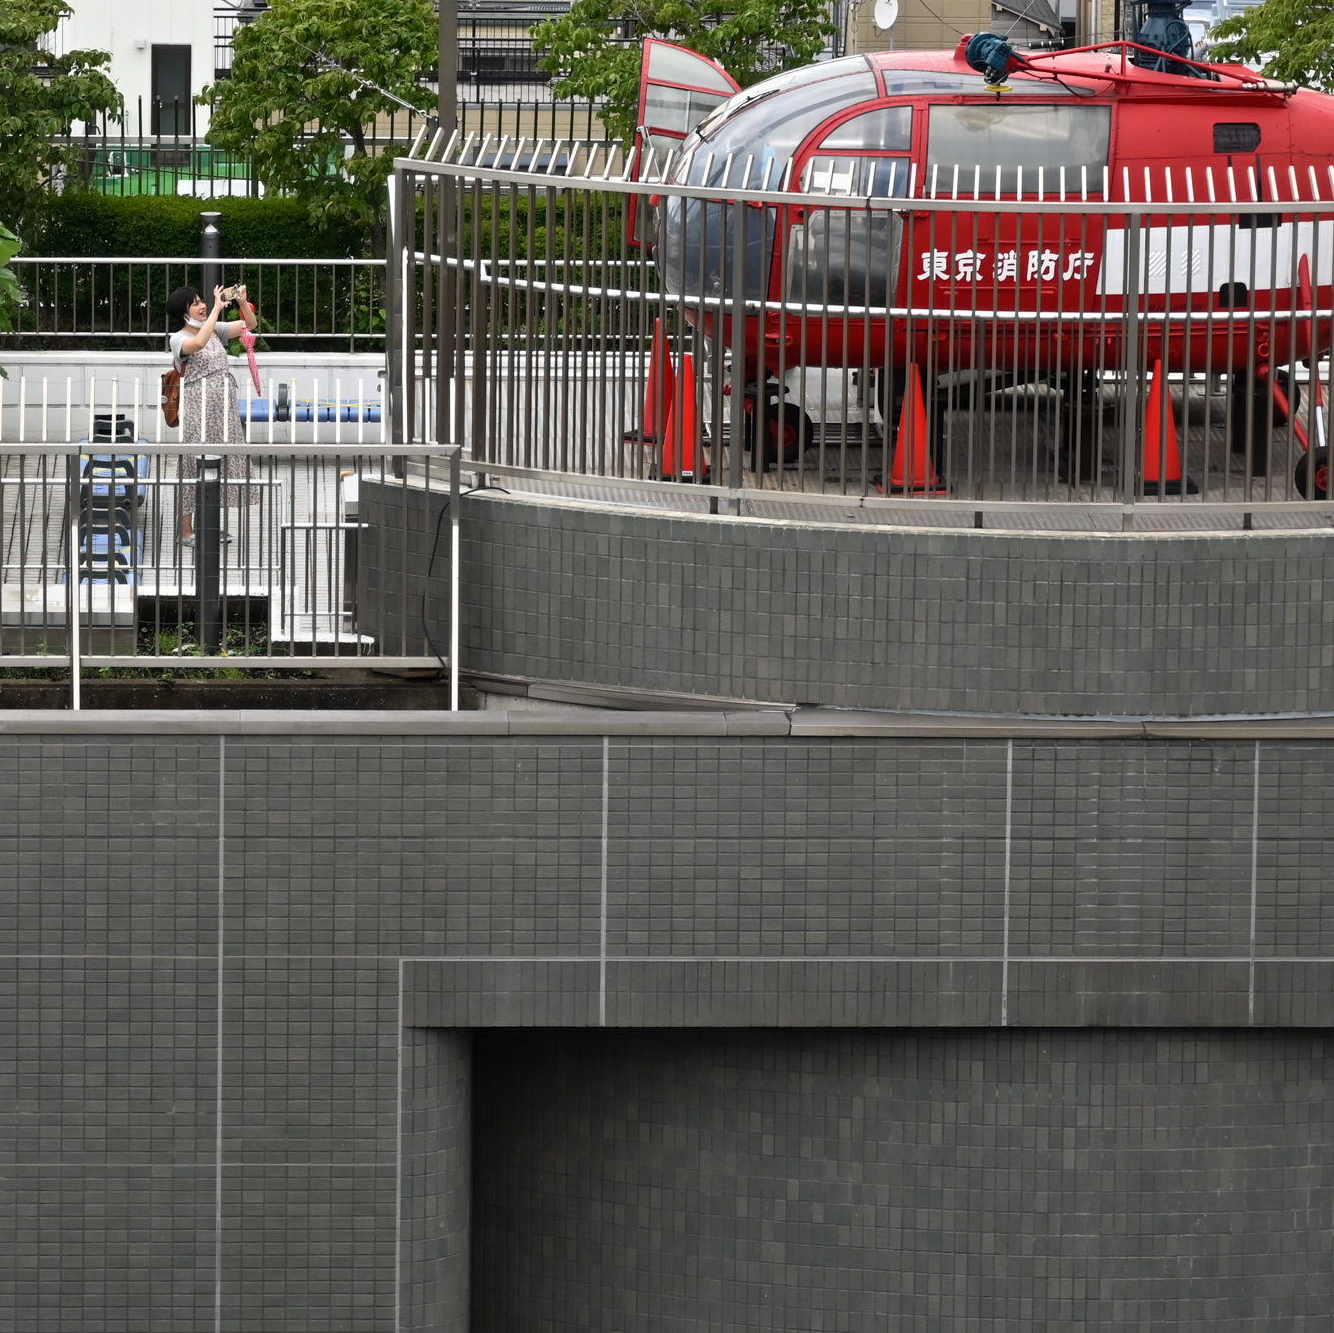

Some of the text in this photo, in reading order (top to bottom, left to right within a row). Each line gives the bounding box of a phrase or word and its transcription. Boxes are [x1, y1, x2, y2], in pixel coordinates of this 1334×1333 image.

[917, 248, 1095, 282] 東京消防庁
